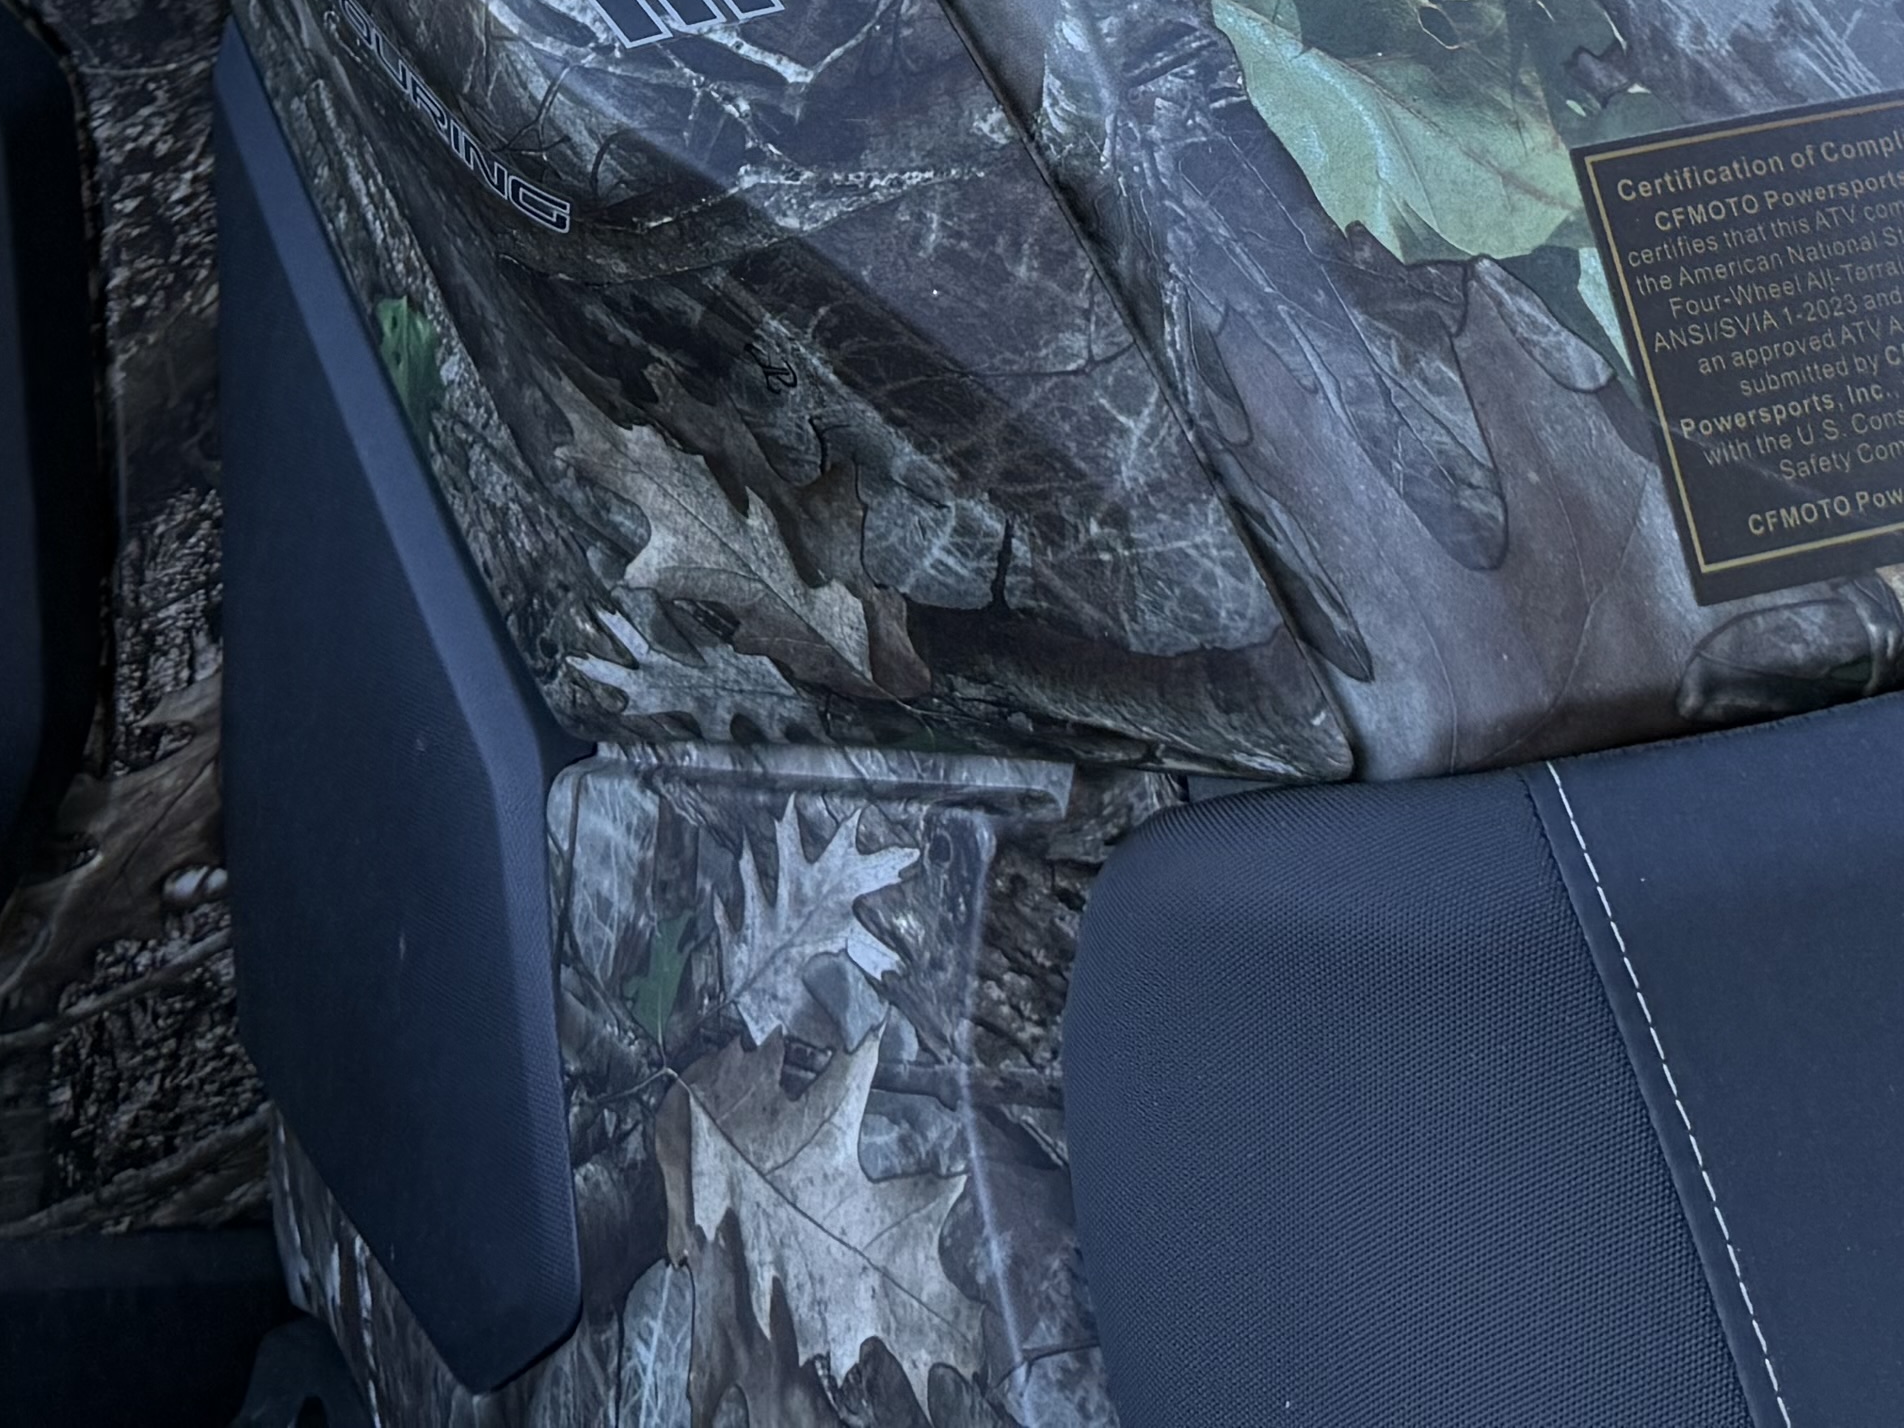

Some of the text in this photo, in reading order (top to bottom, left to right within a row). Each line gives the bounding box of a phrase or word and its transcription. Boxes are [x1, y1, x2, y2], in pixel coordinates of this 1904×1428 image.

[1614, 151, 1785, 202] Certification
[1787, 145, 1819, 170] of
[1625, 231, 1719, 268] certifies
[1722, 223, 1768, 248] that
[1769, 213, 1811, 238] this
[1813, 204, 1859, 229] ATV
[1653, 194, 1760, 231] CFMOTO
[1635, 270, 1673, 296] the
[1675, 249, 1784, 287] American
[1786, 230, 1879, 266] National
[1651, 310, 1778, 352] ANSI/SVIA
[1779, 292, 1858, 325] 1-2023
[1859, 284, 1903, 310] and
[1668, 275, 1803, 320] Four-Wheel
[1696, 354, 1726, 374] an
[1729, 328, 1837, 372] approved
[1837, 318, 1885, 345] ATV
[1737, 355, 1850, 397] submitted
[1852, 349, 1881, 377] by
[1679, 388, 1844, 443] Powersports,
[1701, 438, 1752, 467] with
[1754, 428, 1793, 455] the
[1778, 447, 1854, 486] Safety
[1746, 494, 1852, 536] CFMOTO
